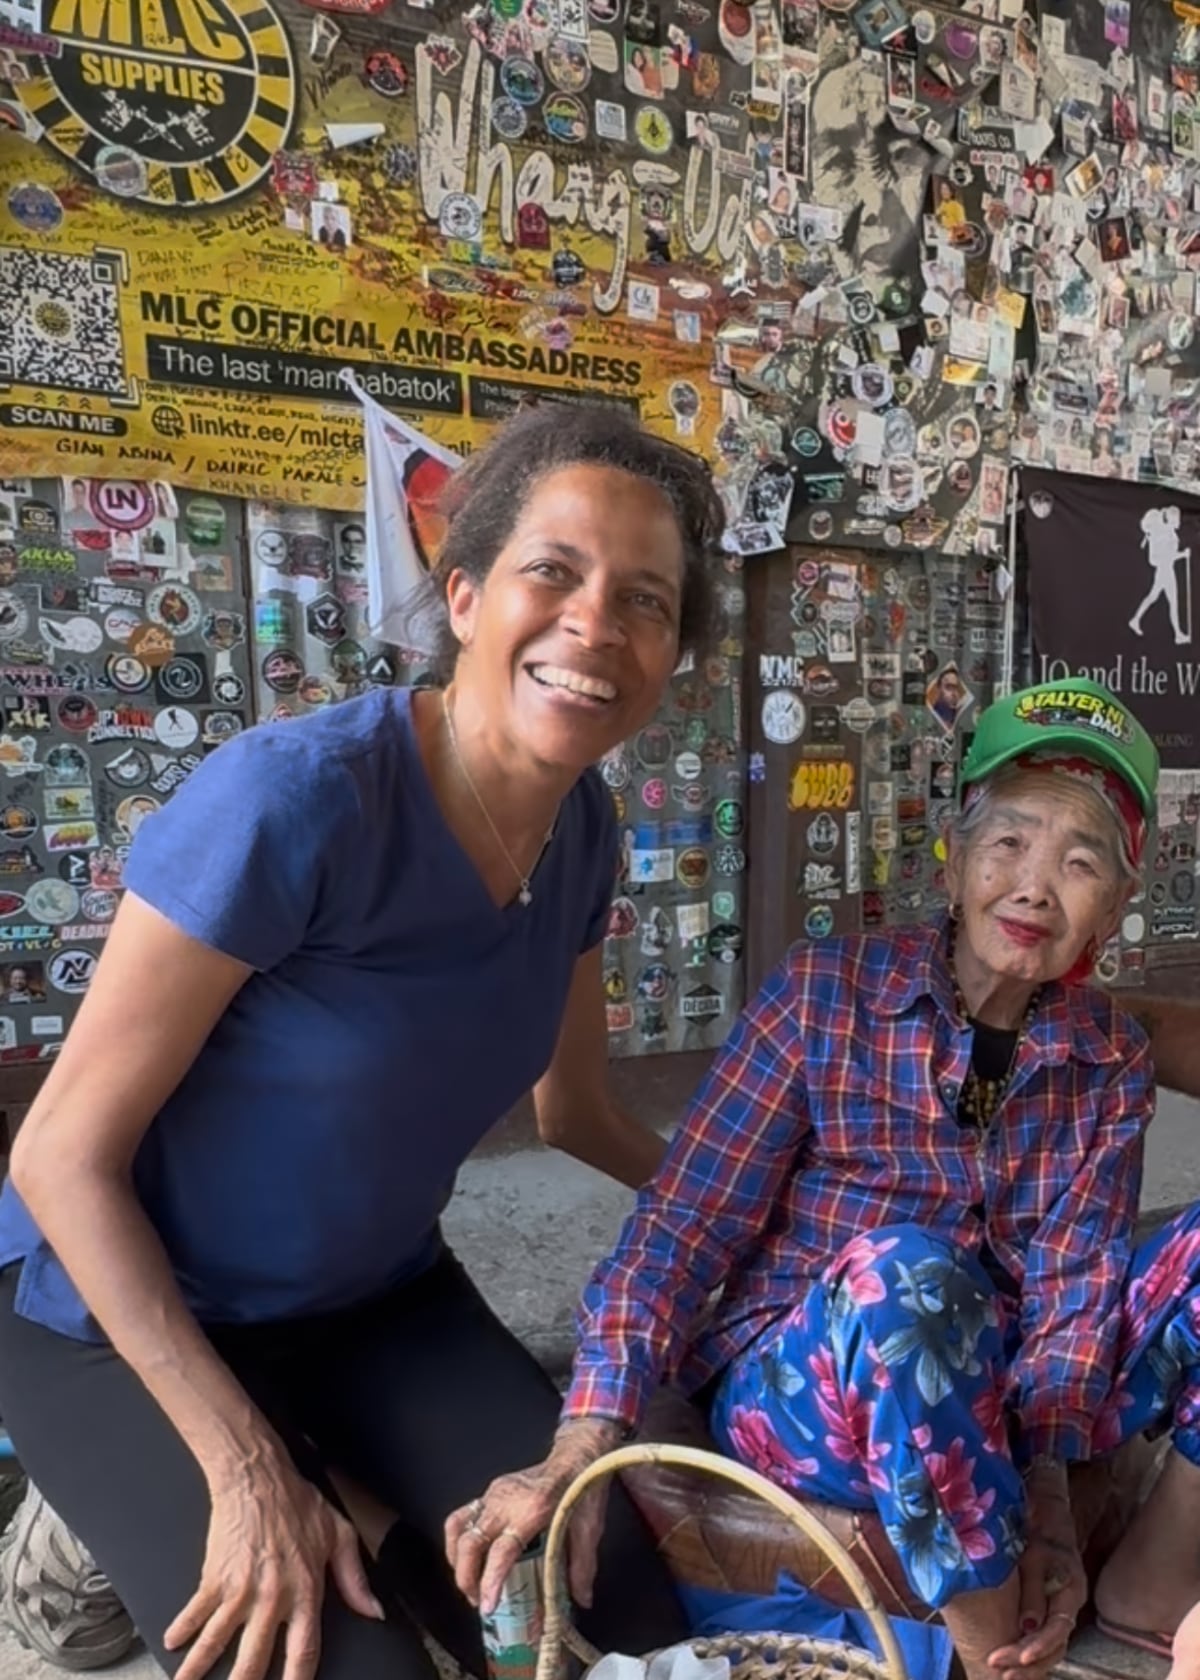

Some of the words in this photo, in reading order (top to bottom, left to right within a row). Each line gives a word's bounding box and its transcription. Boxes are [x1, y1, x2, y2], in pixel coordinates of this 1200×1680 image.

[80, 52, 225, 105] SUPPLIES
[140, 291, 222, 328] MLC
[230, 304, 385, 351] OFFICIAL
[393, 328, 643, 386] AMBASSADRESS
[158, 344, 214, 376] The
[222, 352, 271, 383] last
[10, 406, 73, 428] SCAN
[80, 414, 116, 434] ME
[1131, 656, 1168, 695] the
